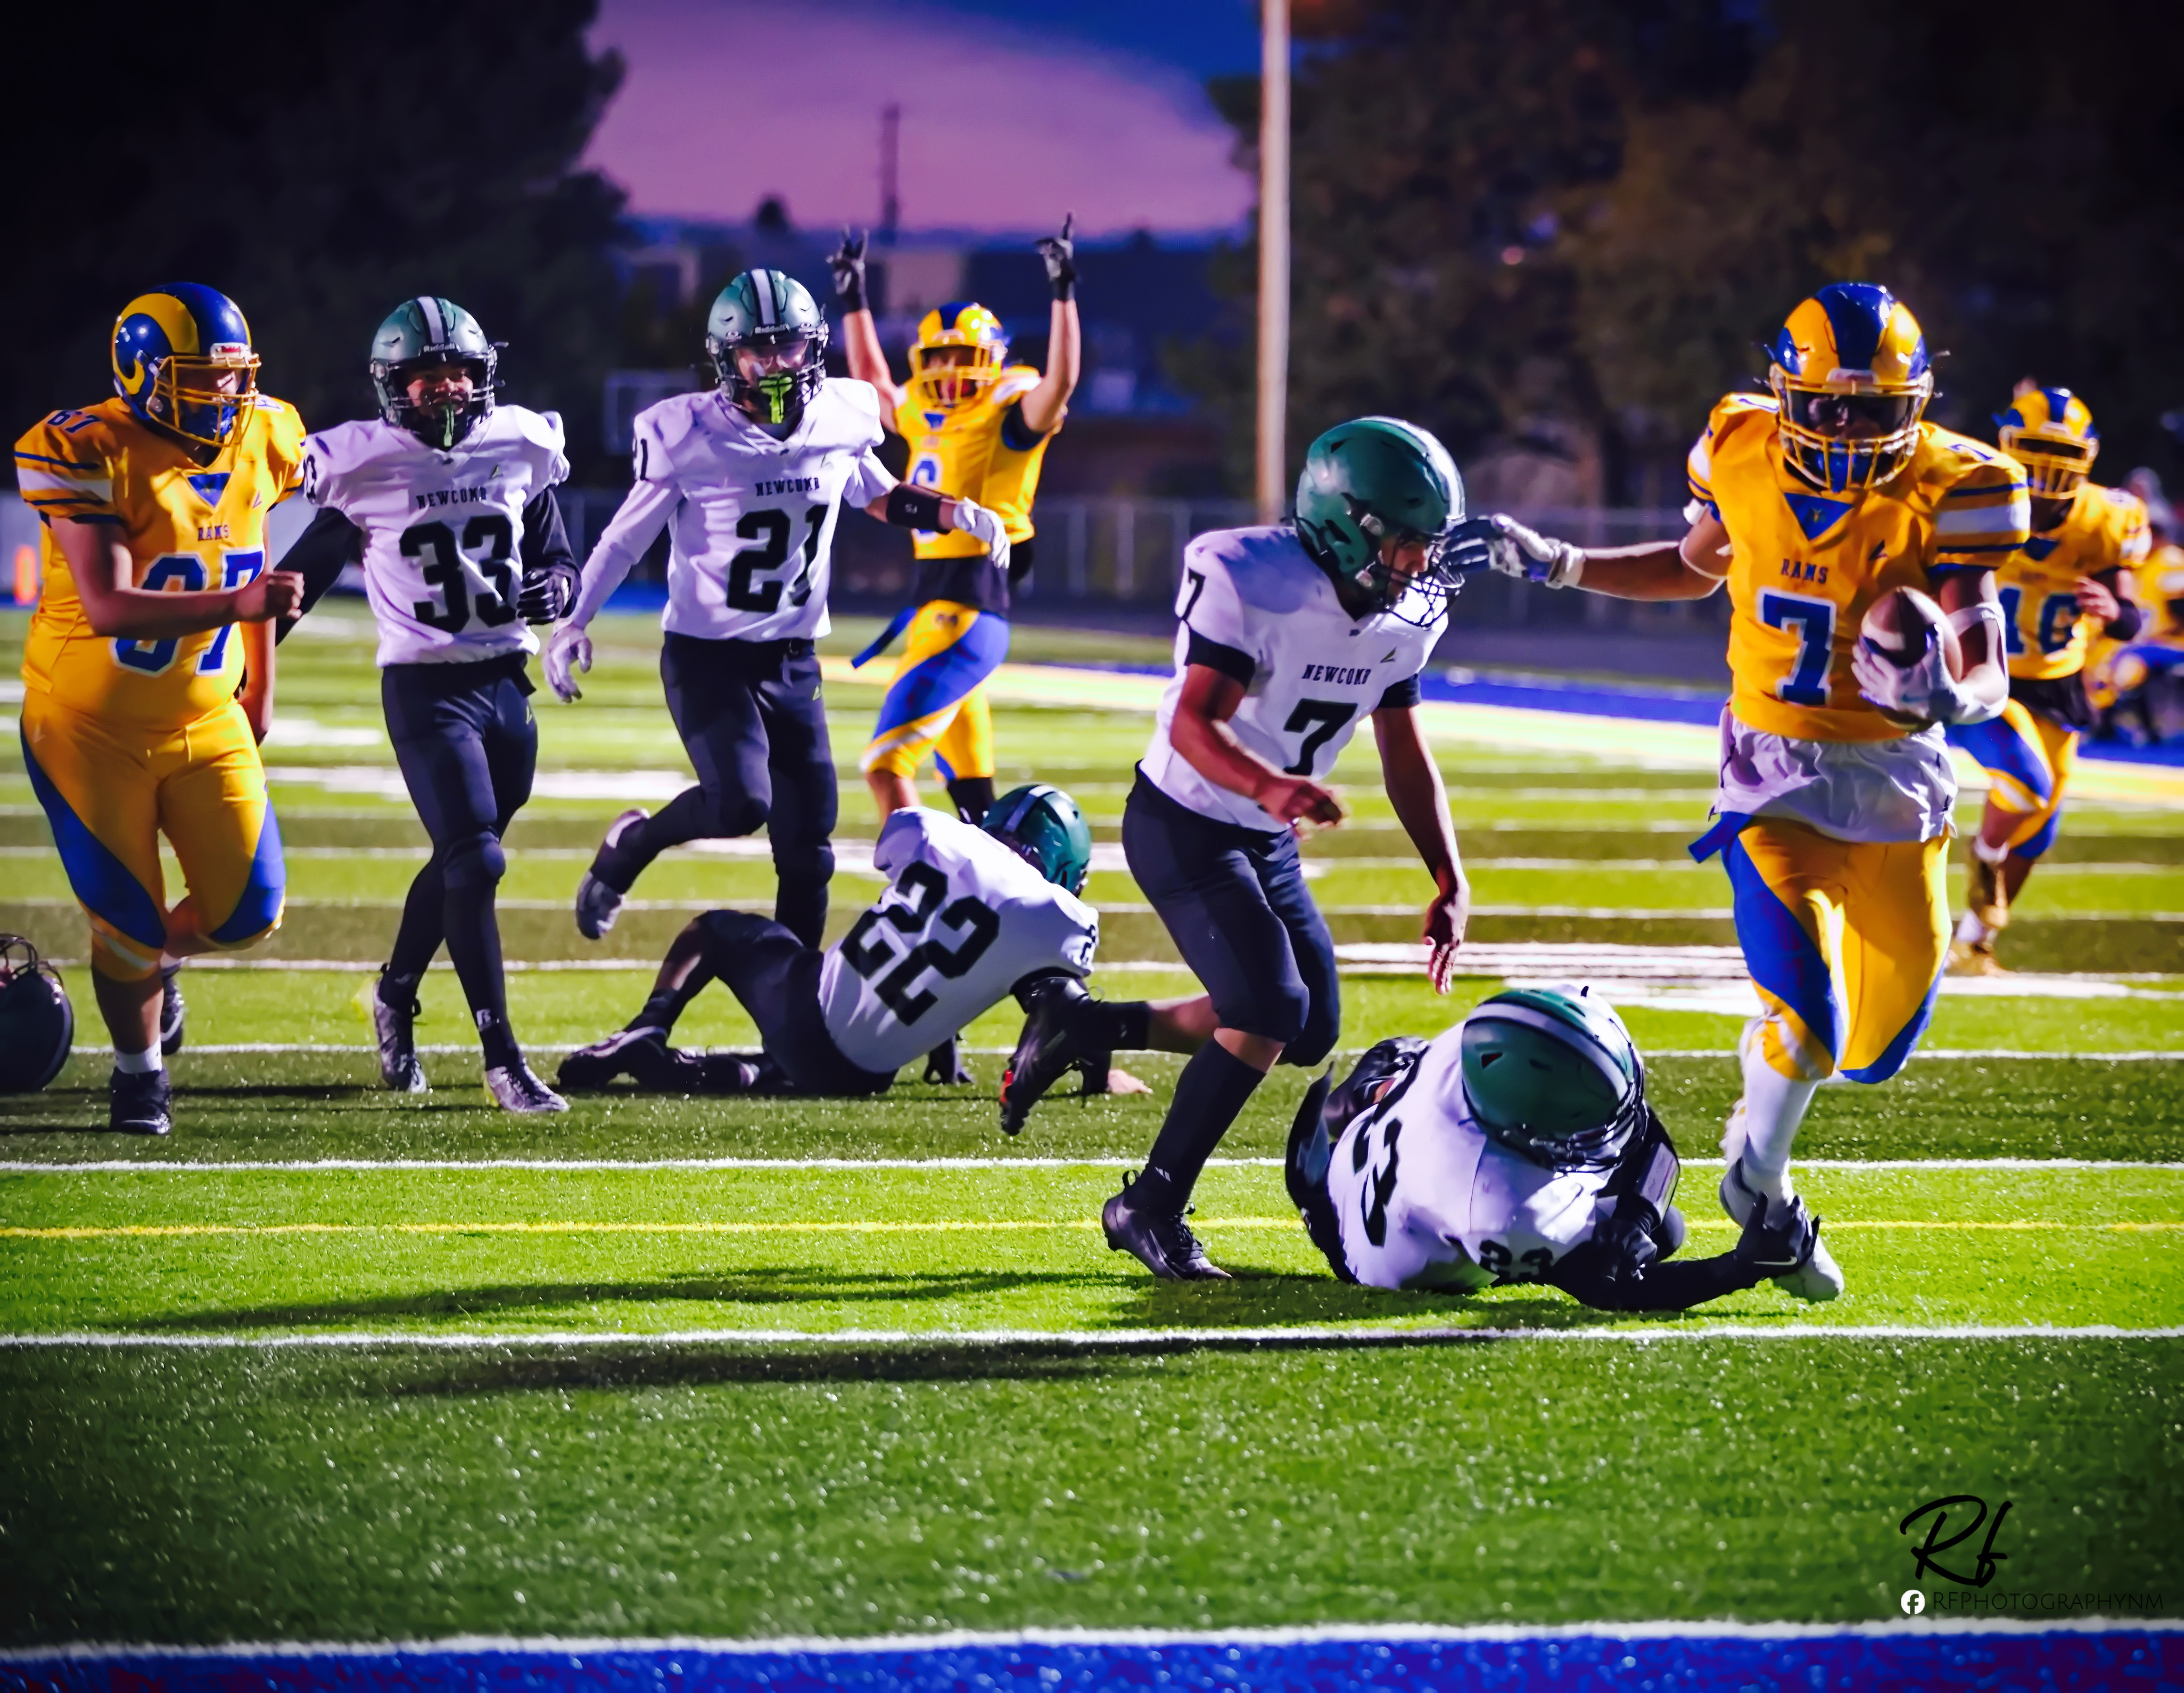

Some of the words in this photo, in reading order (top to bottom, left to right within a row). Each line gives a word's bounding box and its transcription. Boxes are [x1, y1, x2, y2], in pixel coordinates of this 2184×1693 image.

[197, 524, 229, 541] RAMS
[726, 504, 829, 613] 21
[1781, 558, 1829, 584] RAMS
[400, 515, 516, 633] 33
[1175, 567, 1206, 621] 7
[1301, 664, 1372, 686] NEWCOMB
[1757, 587, 1836, 706] 7
[1283, 698, 1358, 777] 7
[839, 860, 1000, 1026] 22
